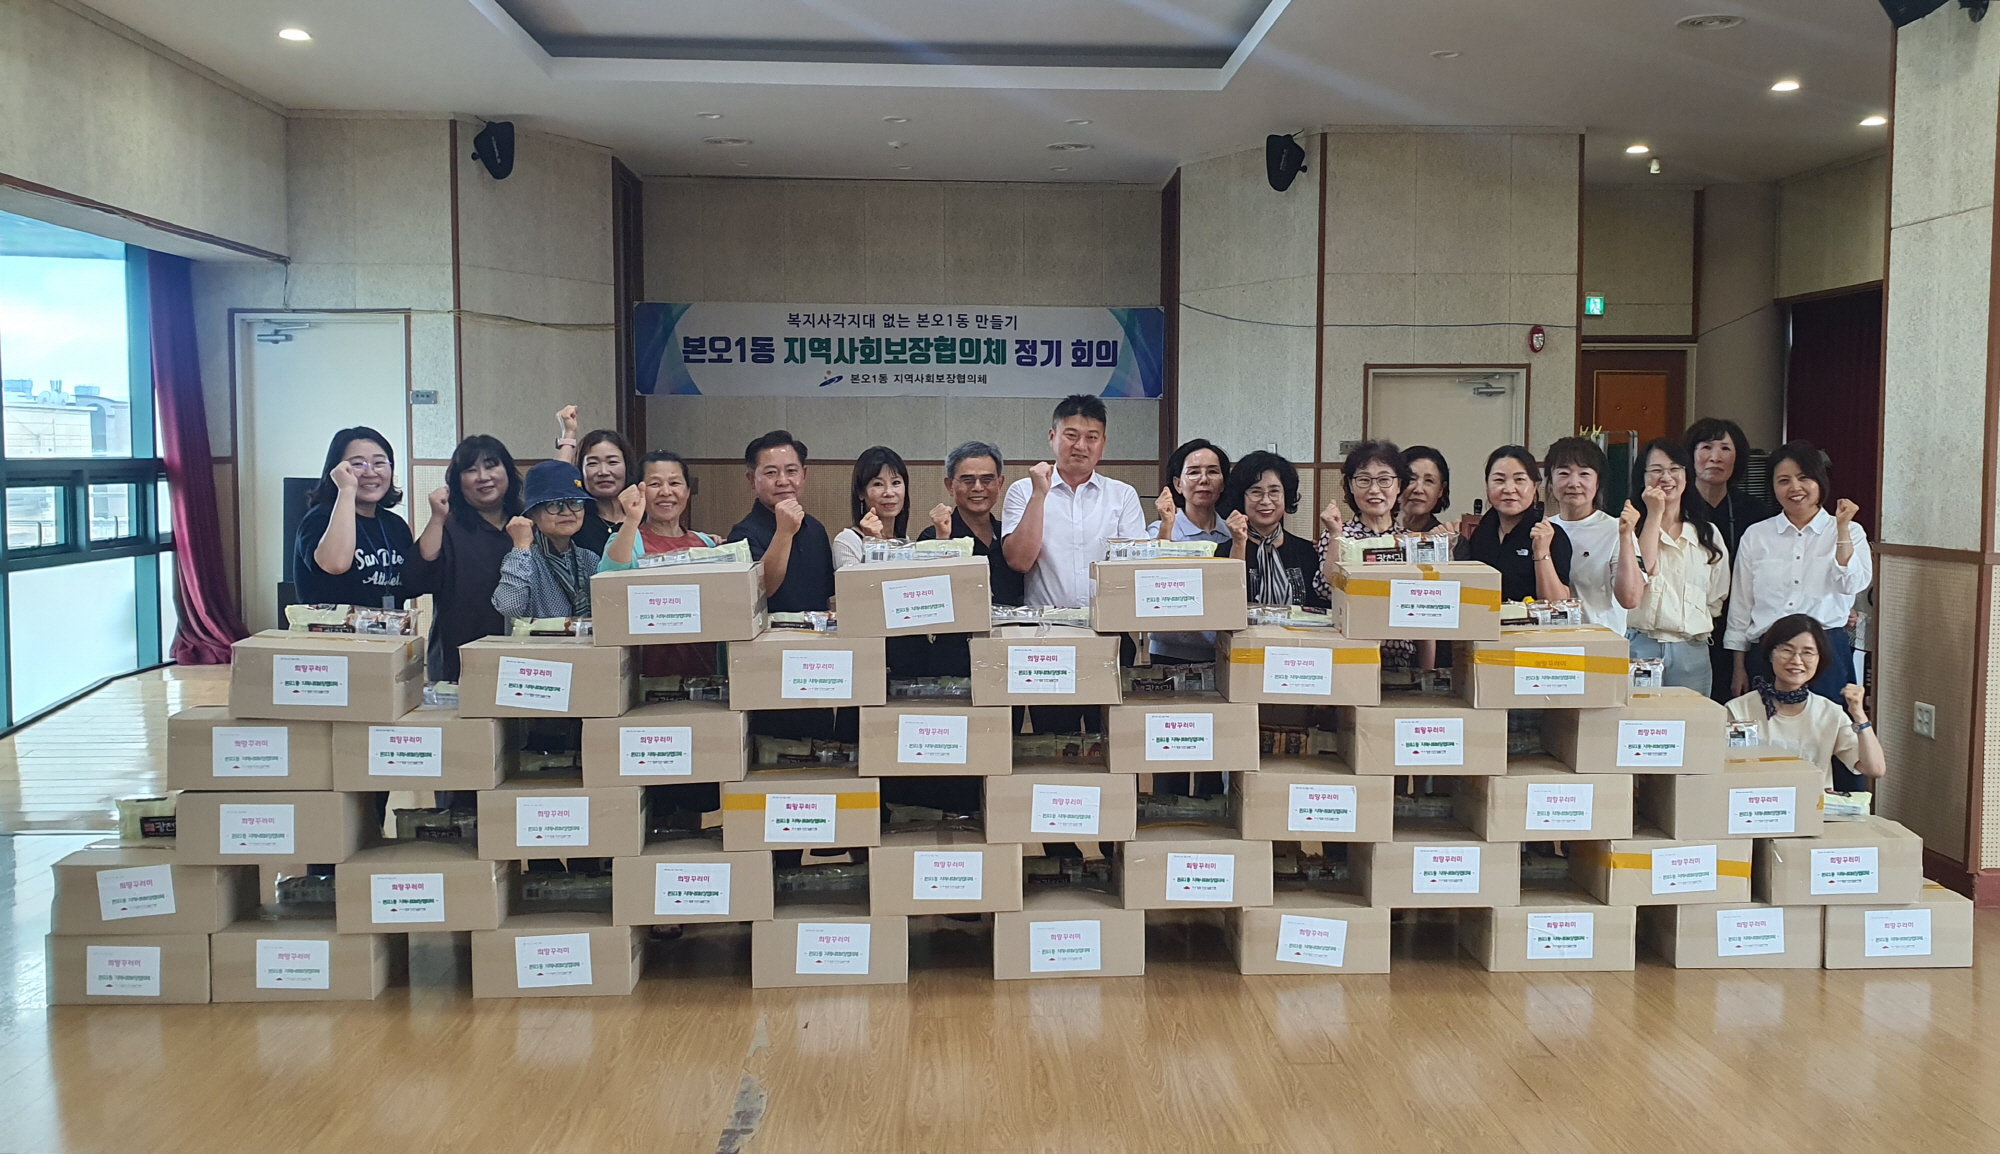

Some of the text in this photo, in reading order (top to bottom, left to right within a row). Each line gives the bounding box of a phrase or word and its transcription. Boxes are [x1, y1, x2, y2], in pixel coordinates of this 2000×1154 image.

[787, 313, 1017, 330] 복지사각지대 없는 본오1동 만들기
[682, 336, 1118, 367] 본오1동 지역사회보장협의체 정기 회의
[850, 373, 987, 384] 본오1동 지역사회보장협의체
[354, 548, 379, 570] San
